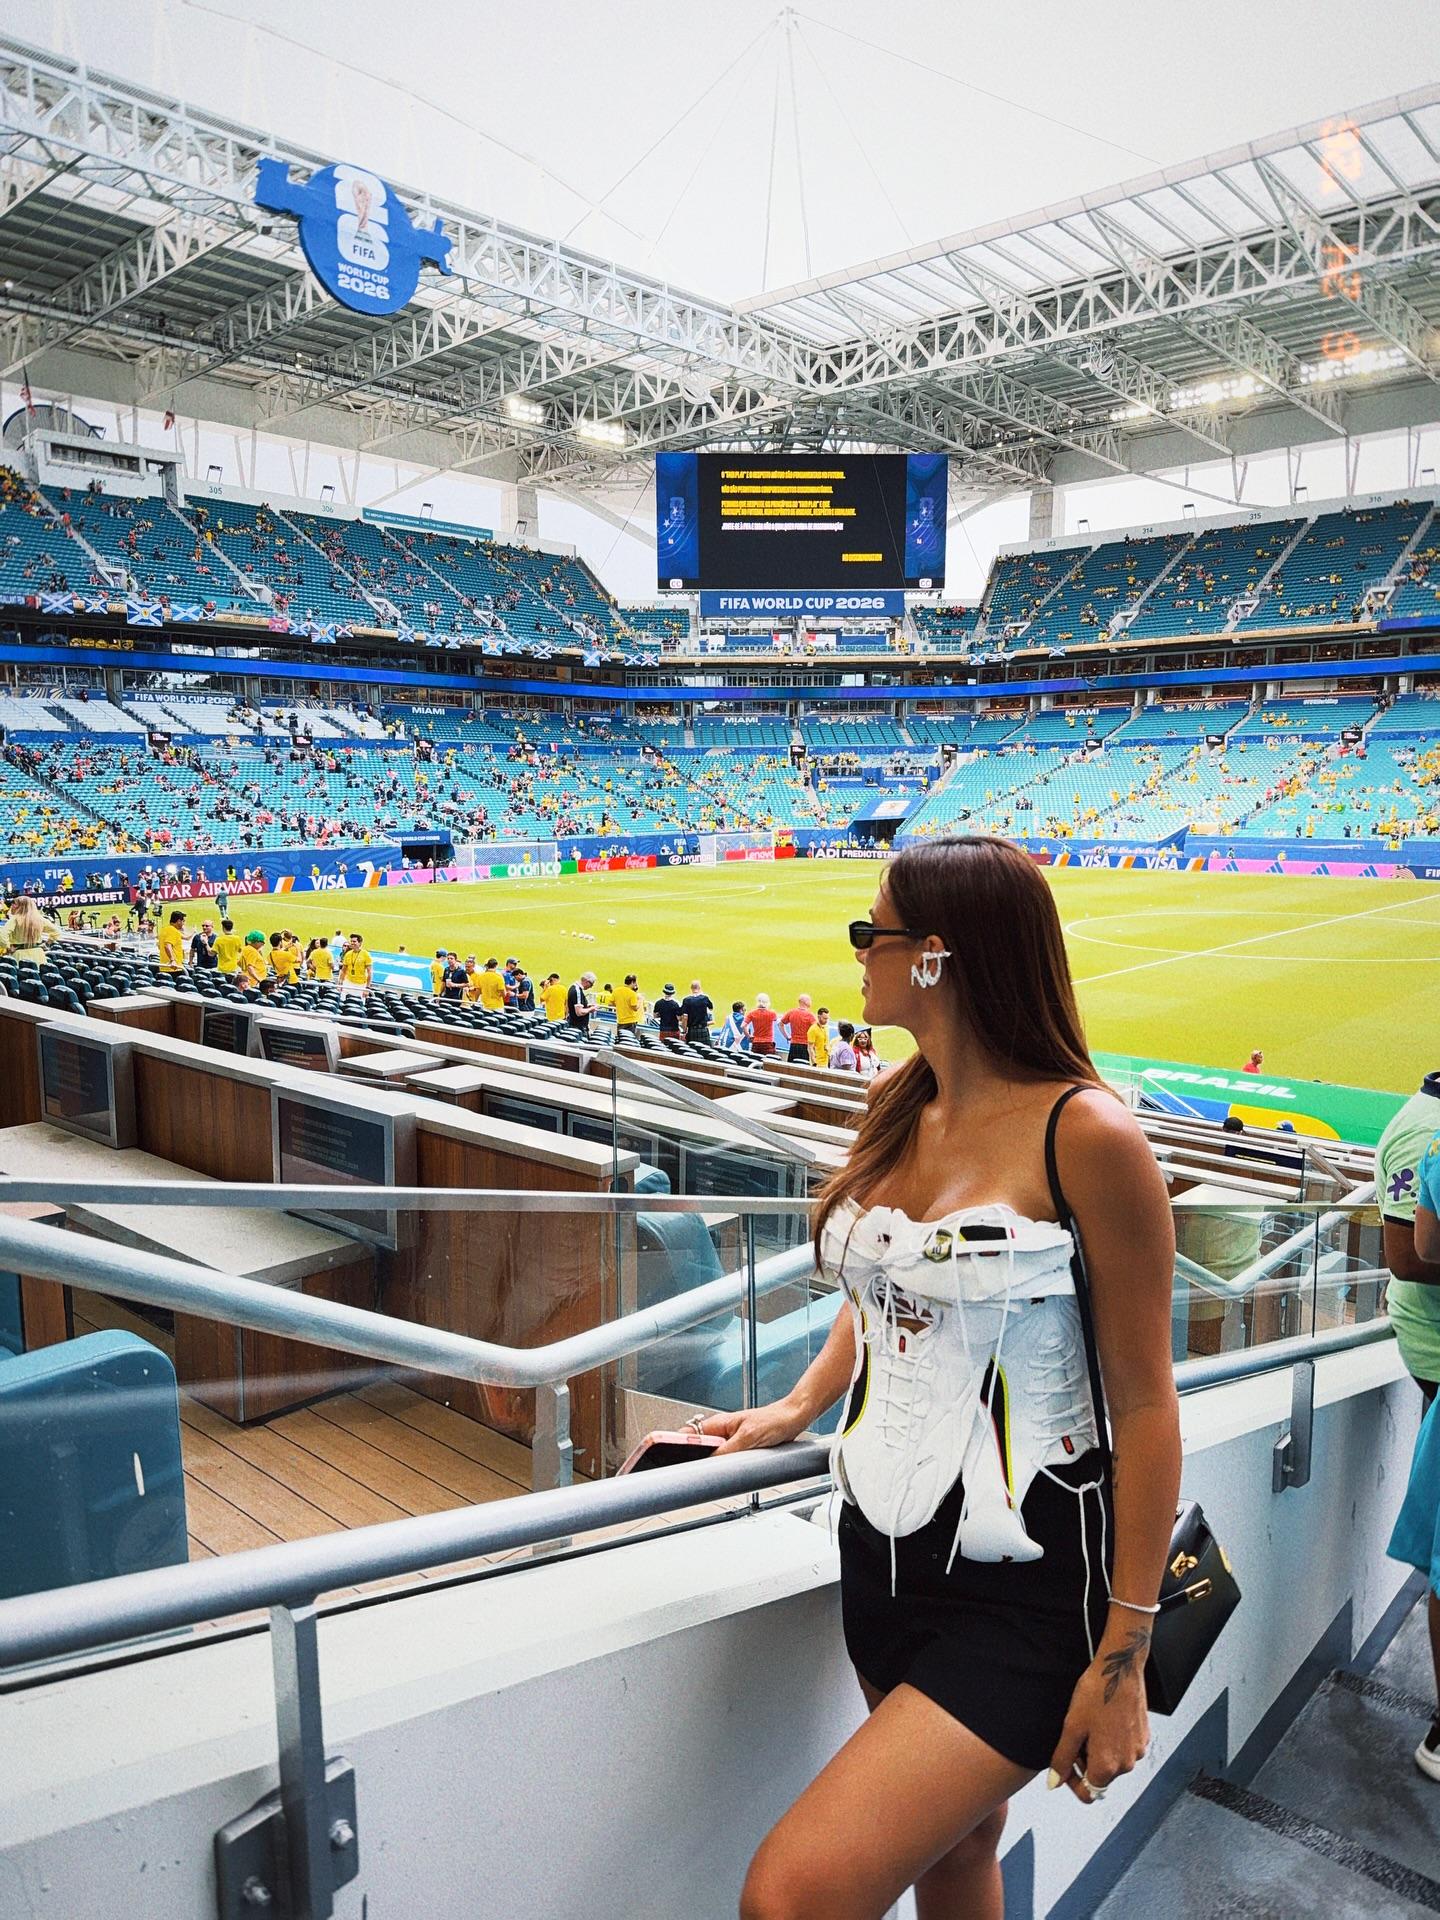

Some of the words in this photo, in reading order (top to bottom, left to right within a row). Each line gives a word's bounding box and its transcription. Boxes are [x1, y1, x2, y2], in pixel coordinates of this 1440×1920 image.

[353, 244, 376, 261] FIFA
[338, 262, 371, 280] WORLD
[371, 273, 390, 285] CUP
[337, 273, 390, 300] 2026
[209, 486, 223, 494] 305
[1250, 512, 1261, 520] 315
[720, 598, 749, 609] FIFA
[752, 598, 803, 609] WORLD
[805, 598, 833, 609] CUP
[836, 597, 885, 609] 2026
[135, 693, 154, 701] FIFA
[155, 694, 186, 703] WORLD
[188, 695, 205, 703] CUP
[206, 696, 236, 705] 2026
[411, 706, 446, 715] MIAMI
[815, 848, 840, 858] ADI
[1079, 855, 1110, 868] VISA
[1143, 856, 1178, 870] VISA
[44, 869, 73, 880] FIFA
[198, 880, 263, 896] AIRWAYS
[308, 873, 348, 891] VISA
[1142, 1068, 1297, 1099] BRAZIL
